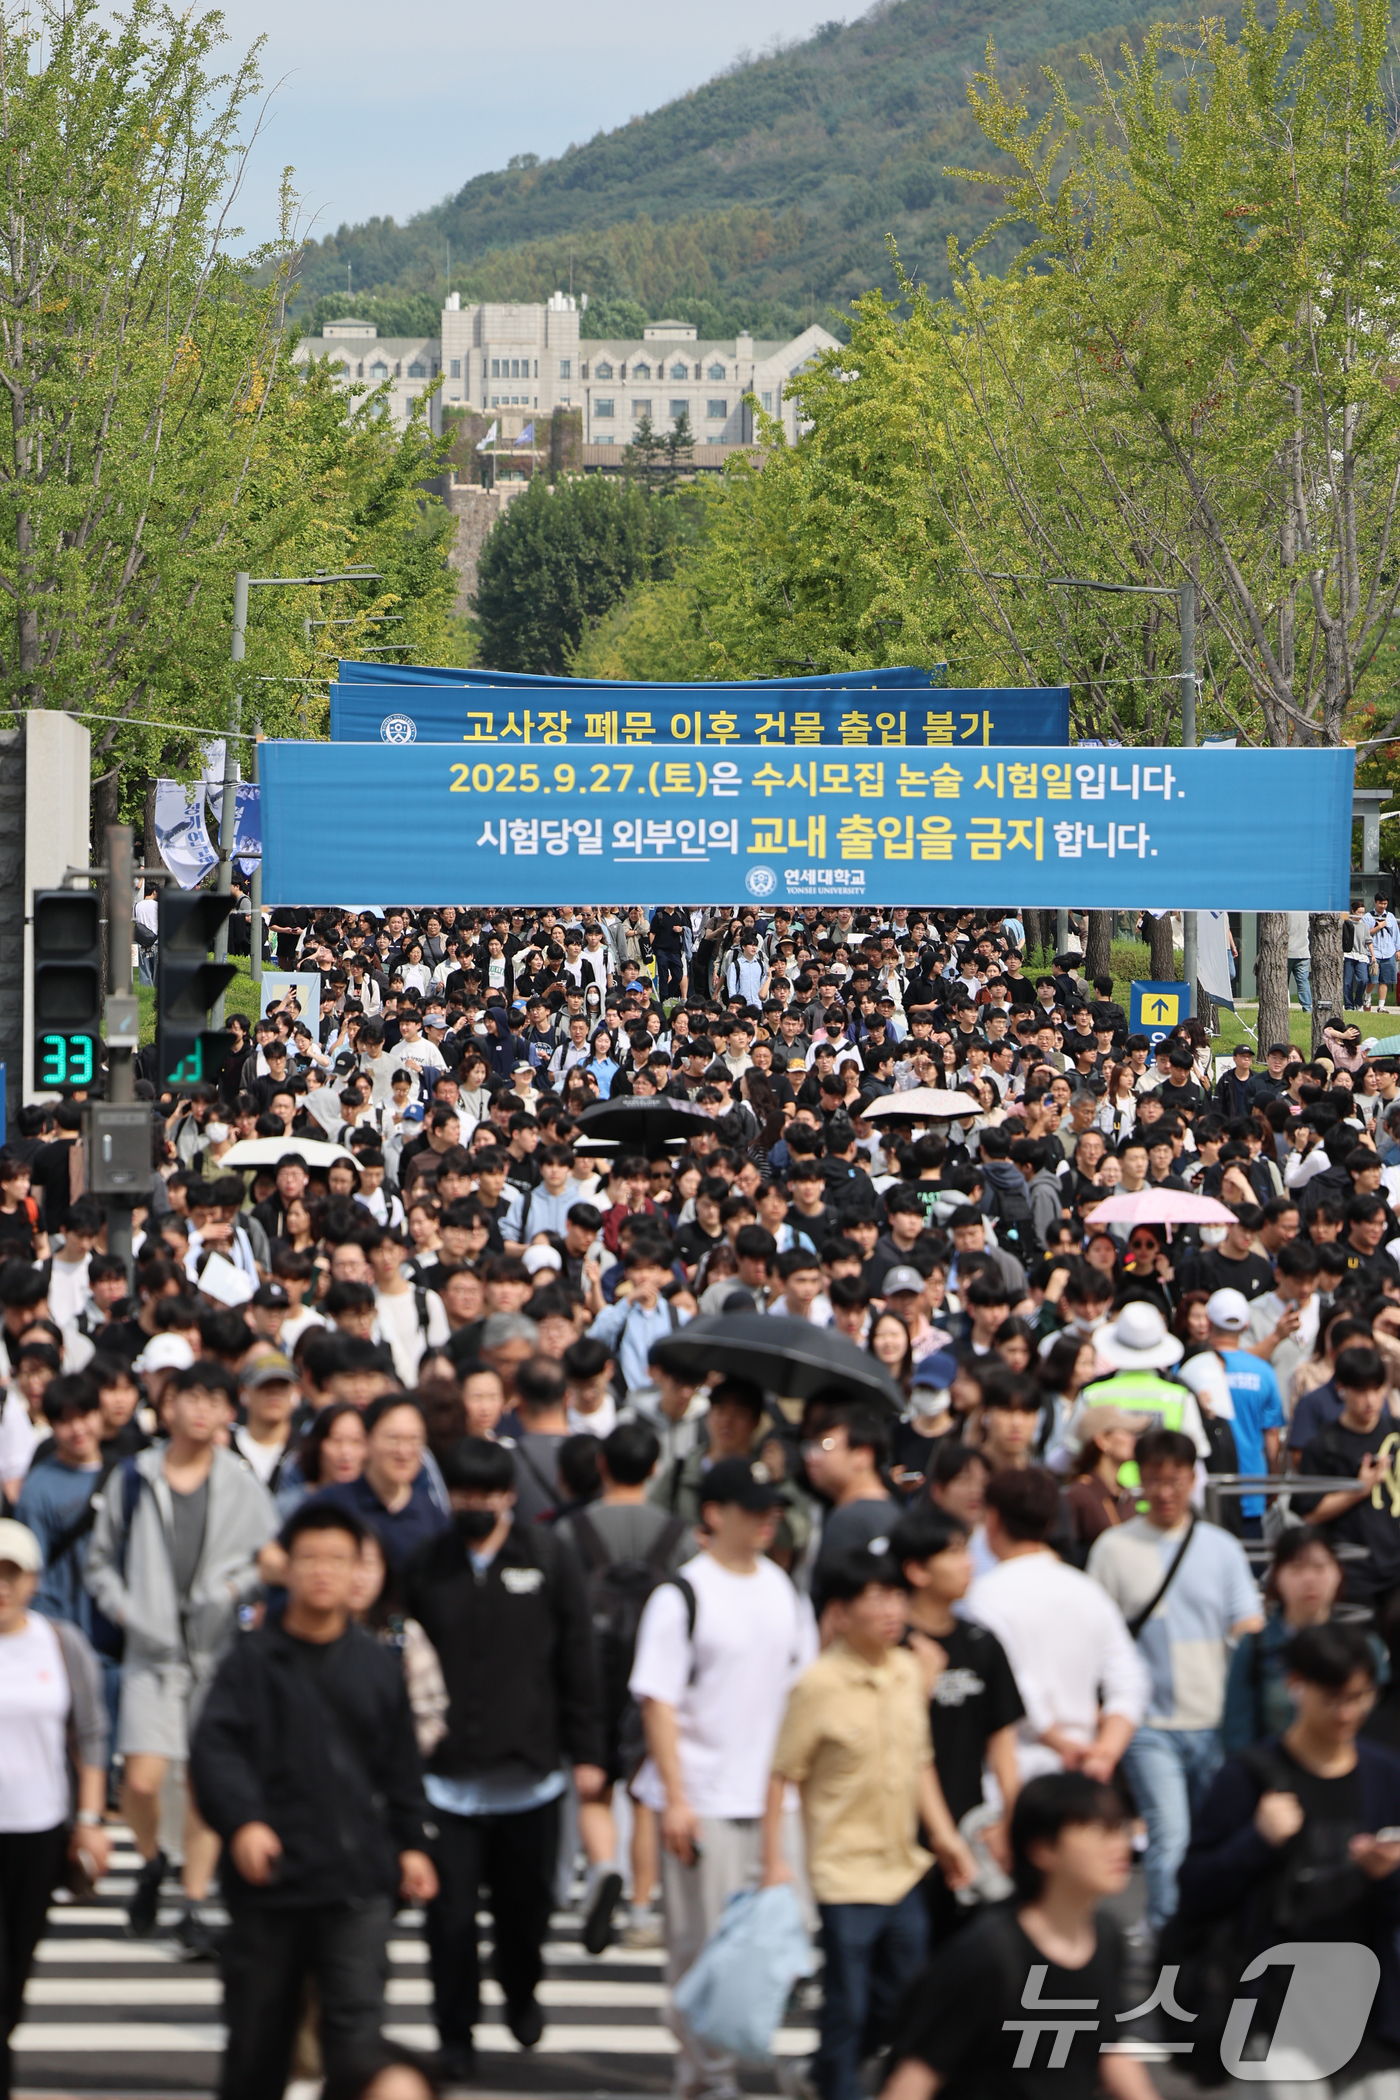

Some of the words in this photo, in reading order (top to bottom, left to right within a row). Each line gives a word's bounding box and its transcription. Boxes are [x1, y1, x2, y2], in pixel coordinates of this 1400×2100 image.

[462, 710, 572, 744] 고사장
[584, 711, 656, 744] 폐문
[670, 711, 741, 744] 이후
[754, 711, 826, 744] 건물
[837, 711, 906, 744] 출입
[922, 711, 994, 744] 불가
[449, 762, 743, 799] 2025.9.27.(토)은
[751, 762, 884, 798] 수시모집
[895, 762, 964, 799] 논술
[973, 762, 1186, 801] 시험일입니다.
[476, 818, 603, 856] 시험당일
[611, 818, 739, 856] 외부인의
[746, 814, 827, 860] 교내
[835, 813, 958, 861] 출입을
[965, 816, 1044, 862] 금지
[1052, 821, 1159, 859] 합니다.
[784, 868, 866, 886] 연세대학교
[786, 887, 817, 895] YONSEI
[818, 887, 866, 895] UNIVERSITY
[43, 1034, 93, 1084] 33
